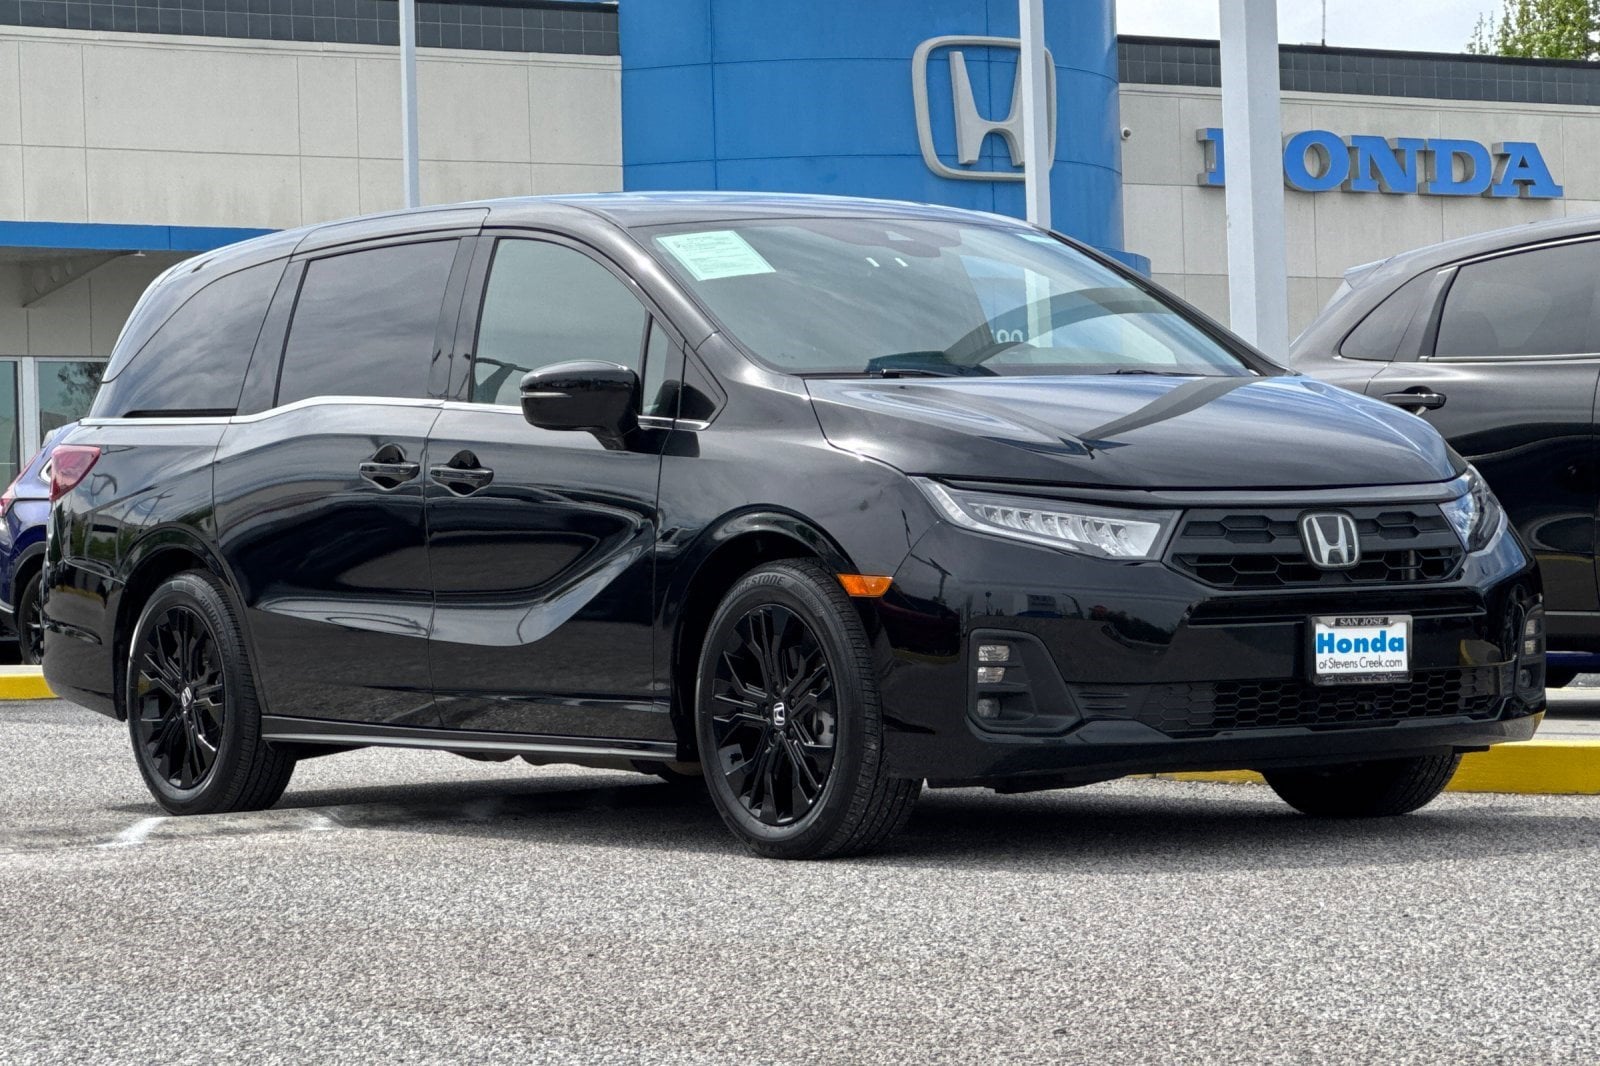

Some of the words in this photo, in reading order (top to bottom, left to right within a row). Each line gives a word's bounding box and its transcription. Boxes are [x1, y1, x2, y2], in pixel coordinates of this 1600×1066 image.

[1340, 618, 1359, 626] SAN
[1317, 630, 1404, 653] Honda
[1319, 660, 1327, 669] of
[1328, 658, 1358, 669] Stevens
[1360, 655, 1402, 668] Creek.com
